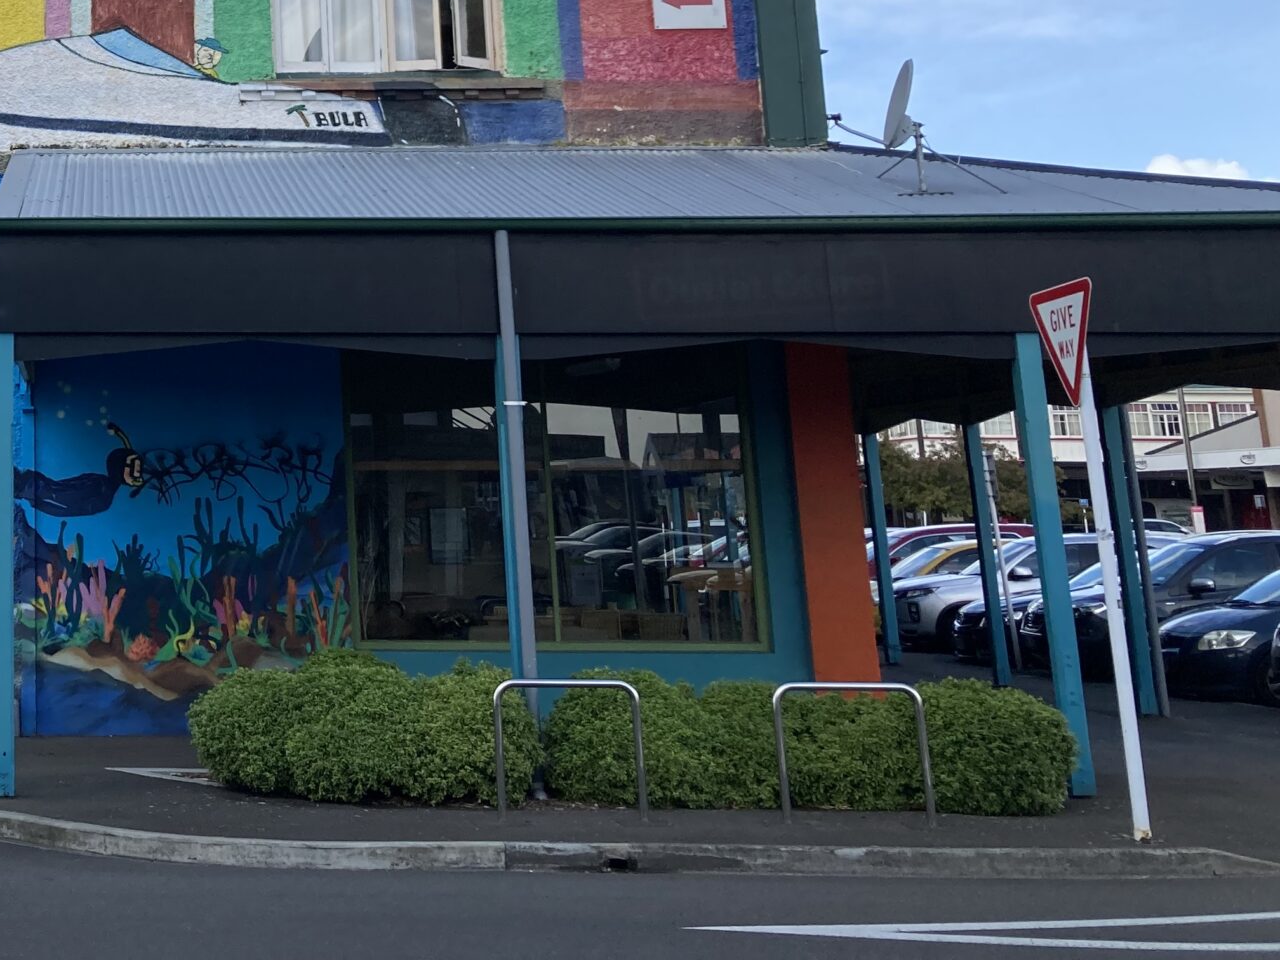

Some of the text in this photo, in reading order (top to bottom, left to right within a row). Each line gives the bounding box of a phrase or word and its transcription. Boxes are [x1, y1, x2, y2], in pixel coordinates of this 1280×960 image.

[314, 111, 369, 127] BULA
[1050, 305, 1076, 332] GIVE
[1058, 338, 1075, 359] WAY
